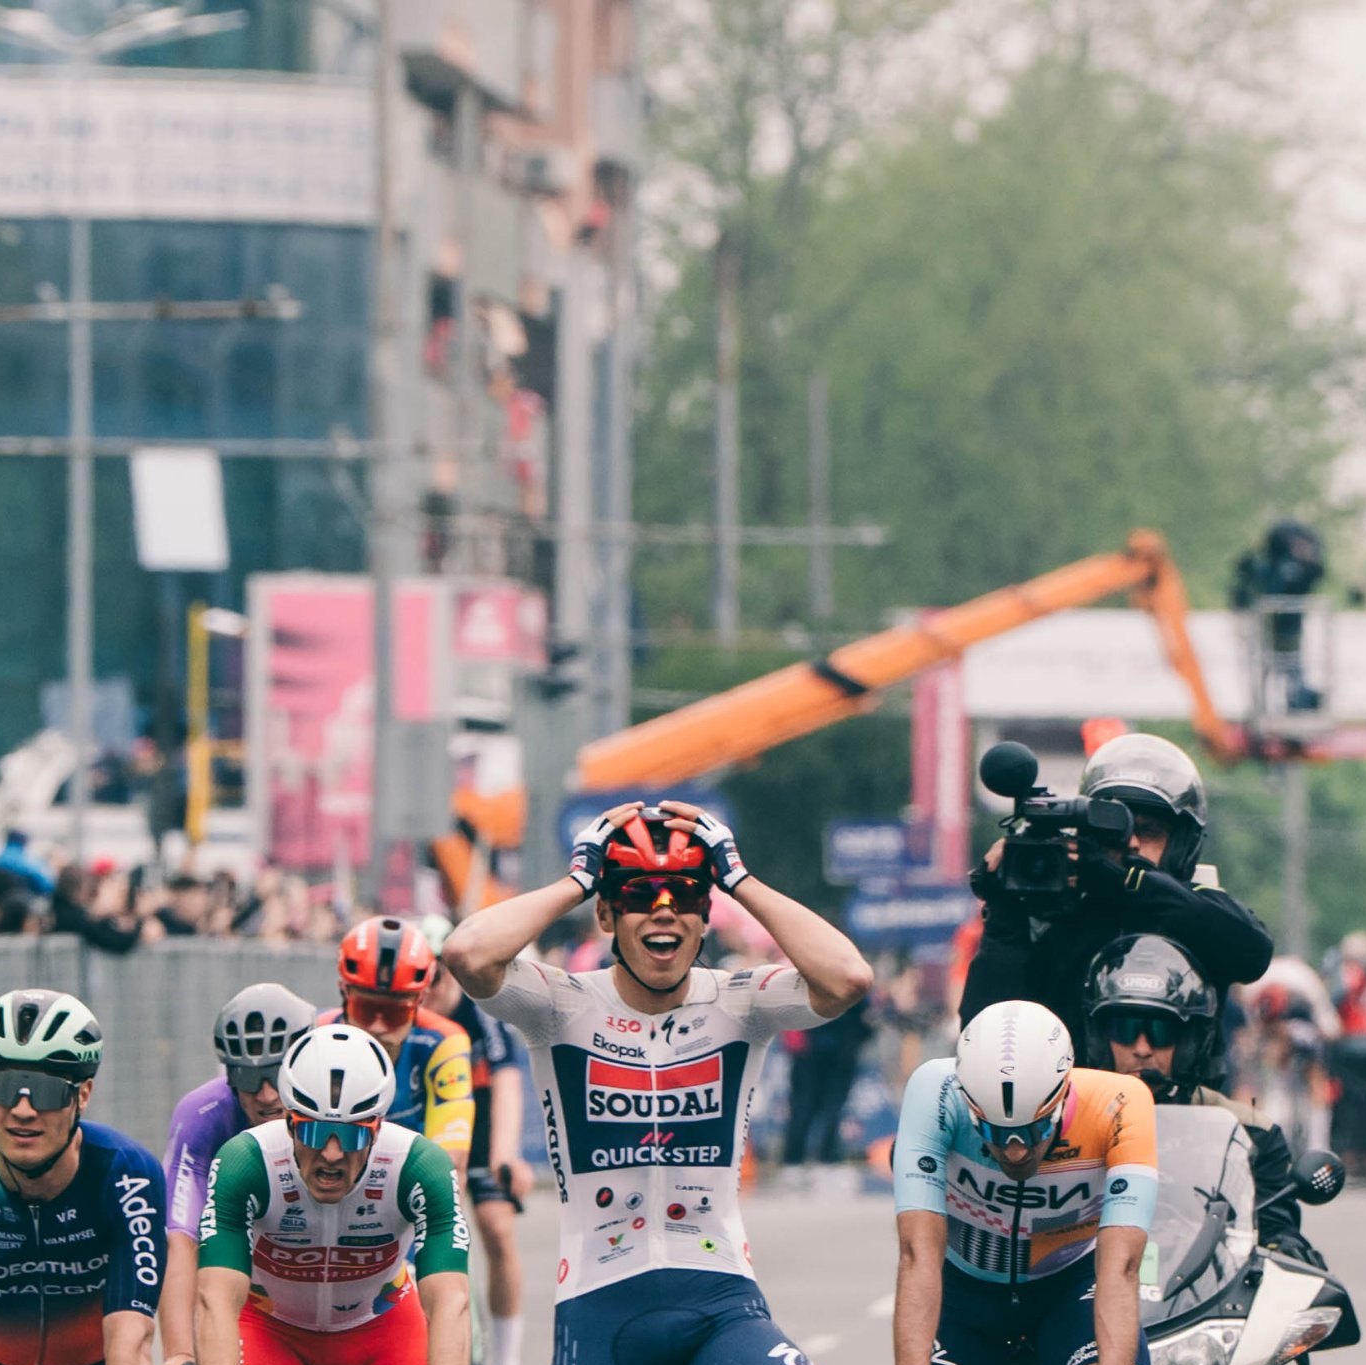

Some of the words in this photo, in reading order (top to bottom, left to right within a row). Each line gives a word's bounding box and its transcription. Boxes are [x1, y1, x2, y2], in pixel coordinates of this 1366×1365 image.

[593, 1032, 646, 1059] Ekopak
[588, 1088, 719, 1118] SOUDAL
[957, 1167, 1091, 1210] NSN
[43, 1235, 67, 1246] VAN
[69, 1229, 97, 1242] RYSEL
[115, 1172, 159, 1286] Adecco
[271, 1247, 384, 1265] POLTI
